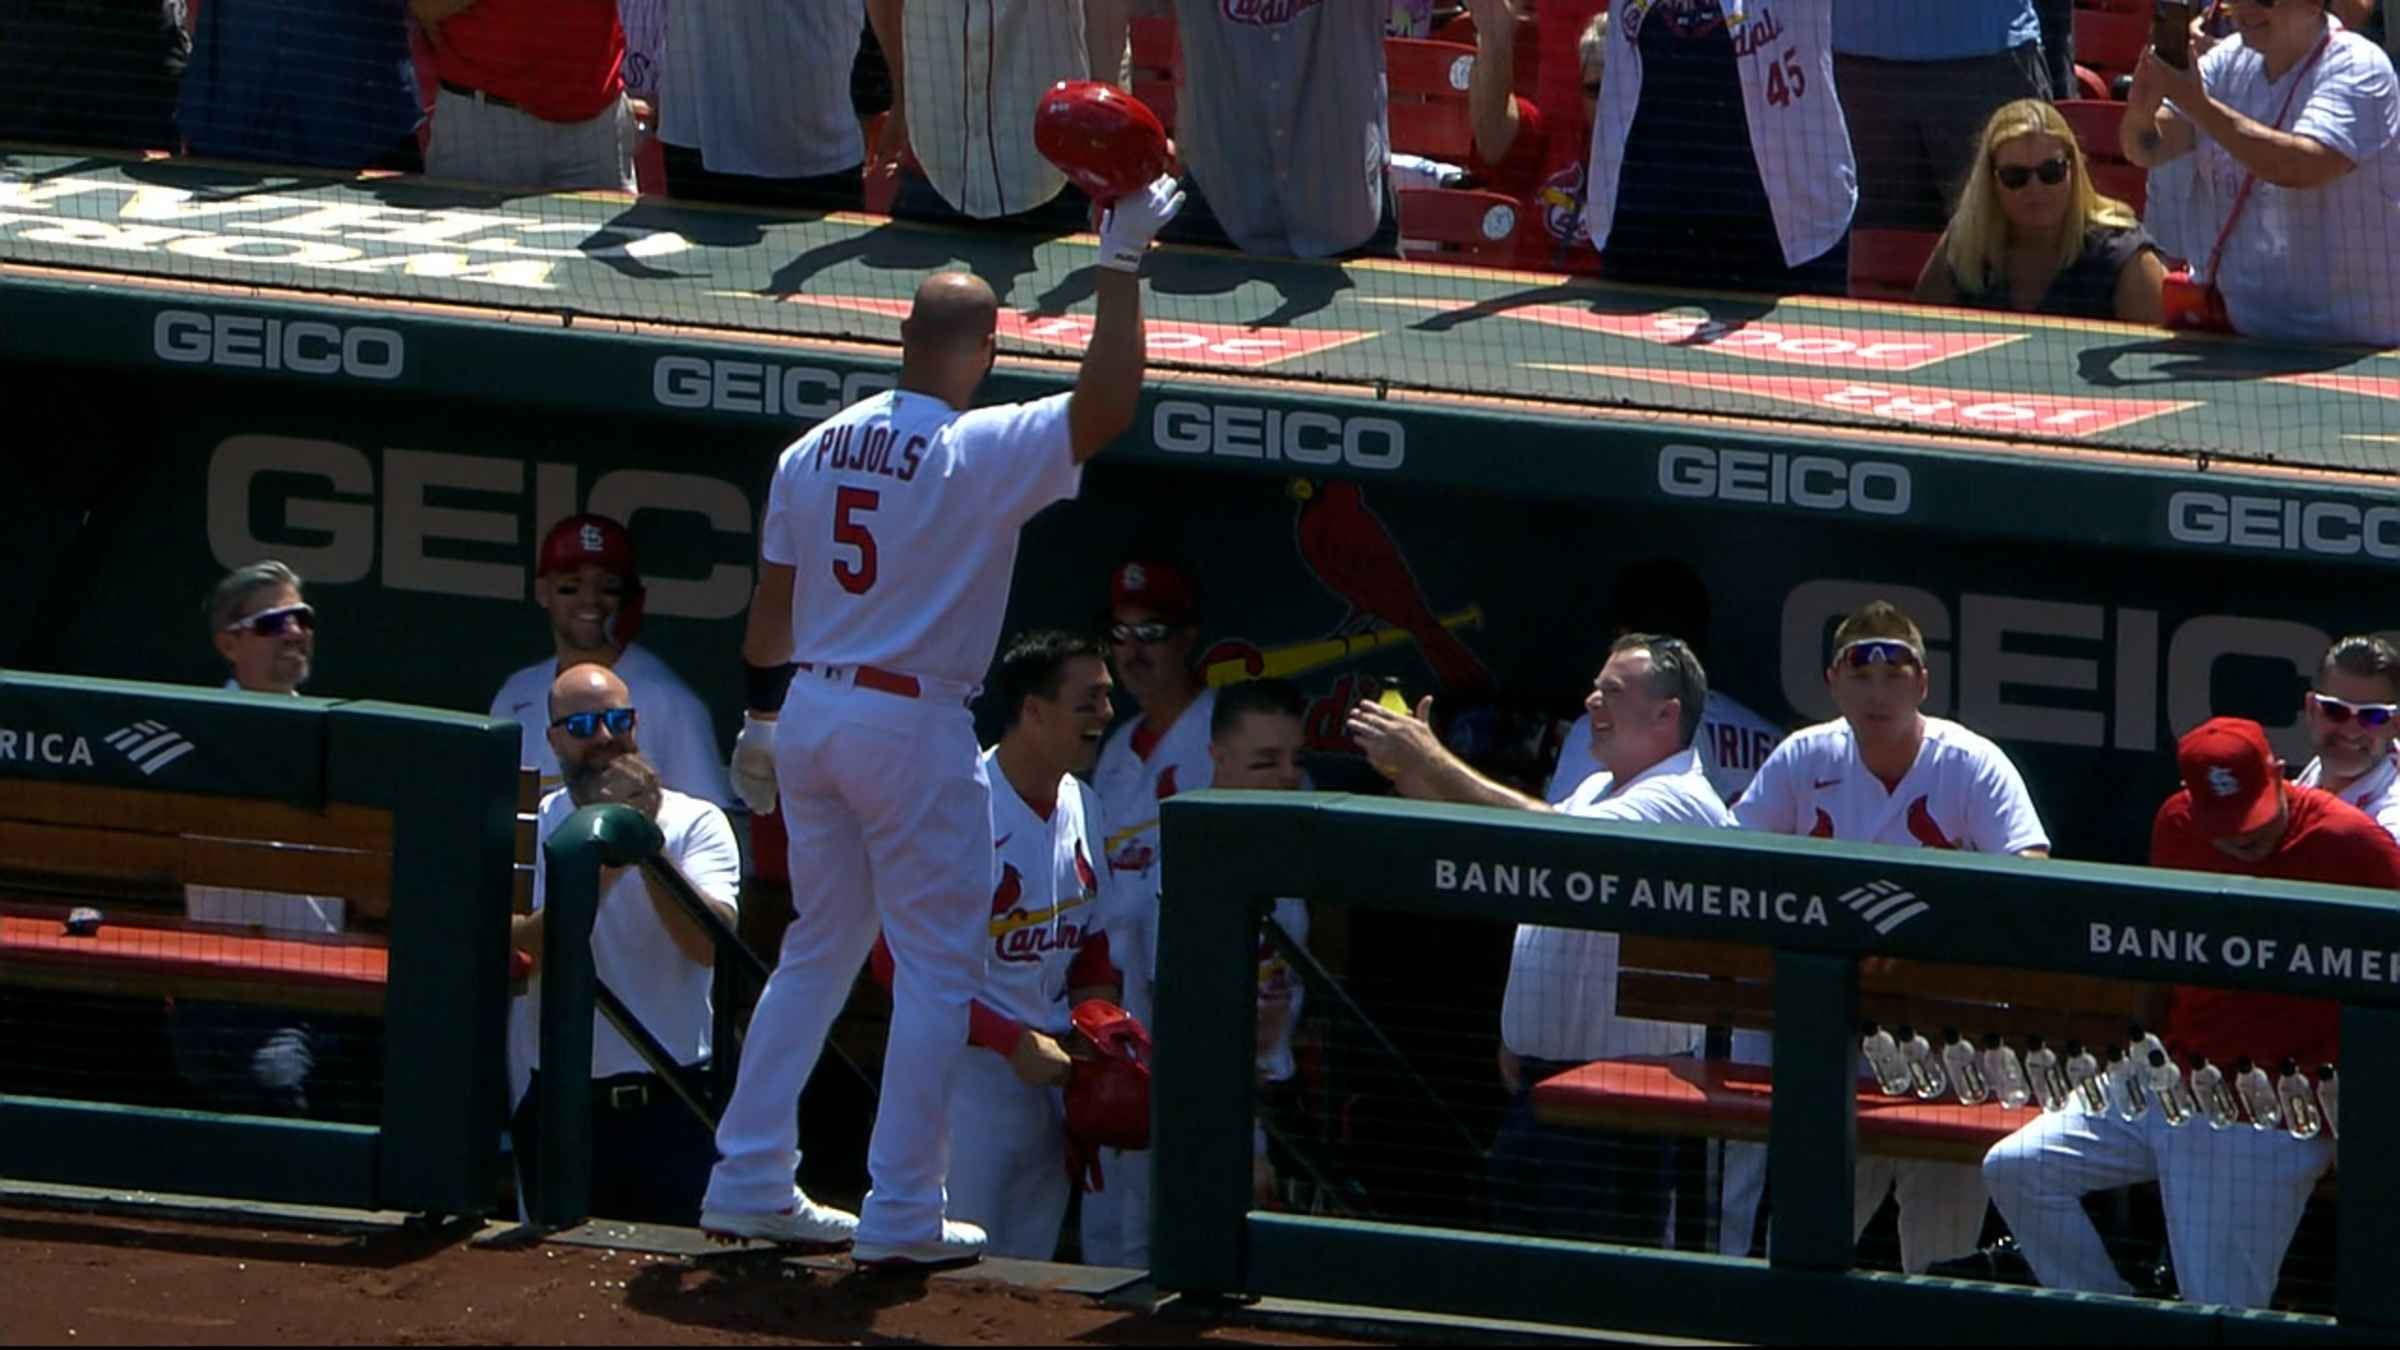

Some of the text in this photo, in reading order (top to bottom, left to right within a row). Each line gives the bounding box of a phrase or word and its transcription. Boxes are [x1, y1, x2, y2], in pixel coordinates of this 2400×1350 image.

[1766, 46, 1806, 107] 45
[0, 180, 693, 259] CHA
[154, 310, 404, 379] GEICO
[1152, 401, 1404, 470] GEICO
[1824, 387, 2105, 425] 1982
[815, 423, 931, 483] PUJOLS
[1658, 444, 1911, 515] GEICO
[832, 486, 881, 596] 5
[1780, 579, 2400, 769] GEIC
[1705, 721, 1783, 771] RIG
[1434, 858, 1831, 929] BANK OF AMERICA
[2088, 921, 2210, 964] BANK
[2221, 934, 2279, 971] OF
